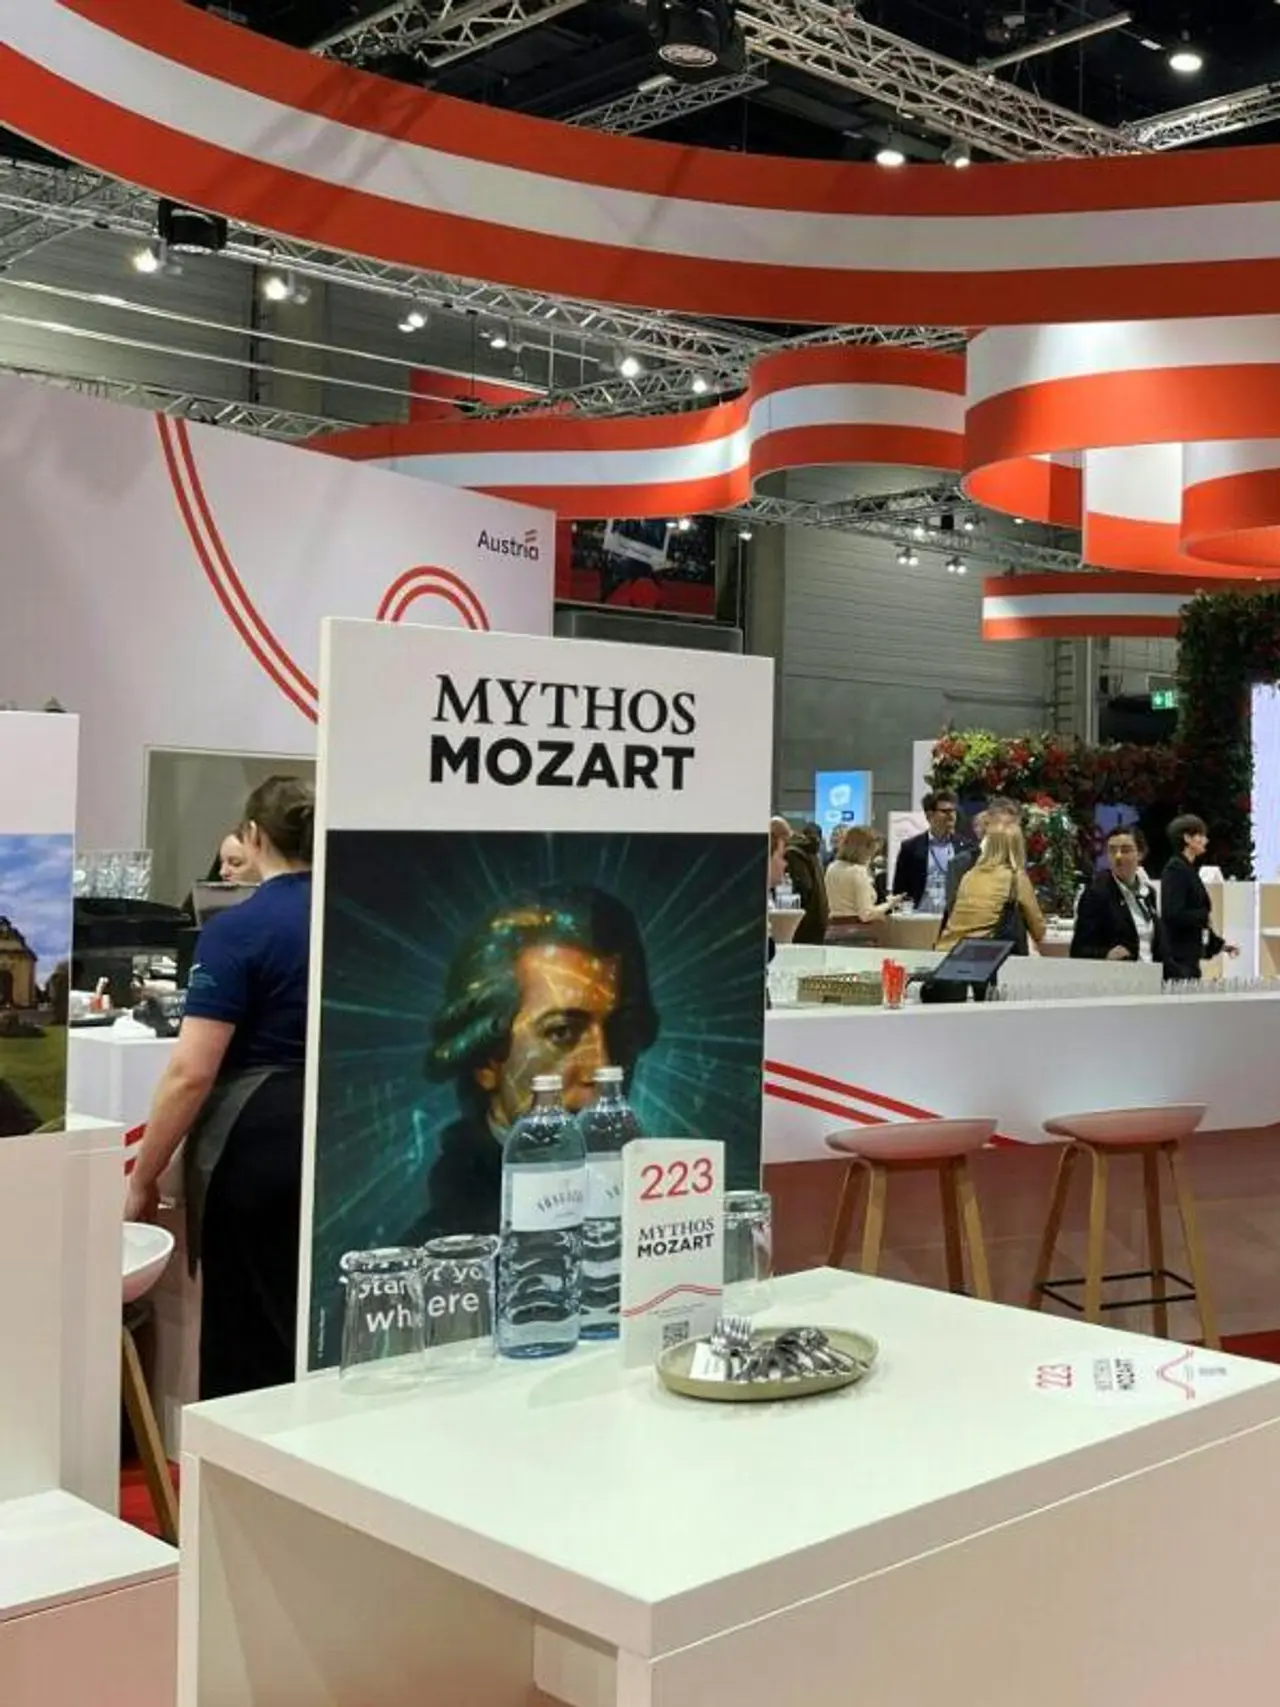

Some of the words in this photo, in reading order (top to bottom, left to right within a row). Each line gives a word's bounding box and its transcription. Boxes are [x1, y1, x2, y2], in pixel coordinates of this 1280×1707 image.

[478, 529, 539, 560] Austria
[431, 674, 697, 735] MYTHOS
[430, 734, 695, 790] MOZART
[640, 1156, 714, 1201] 223
[637, 1233, 715, 1259] MOZART
[638, 1217, 715, 1242] MYTHOS
